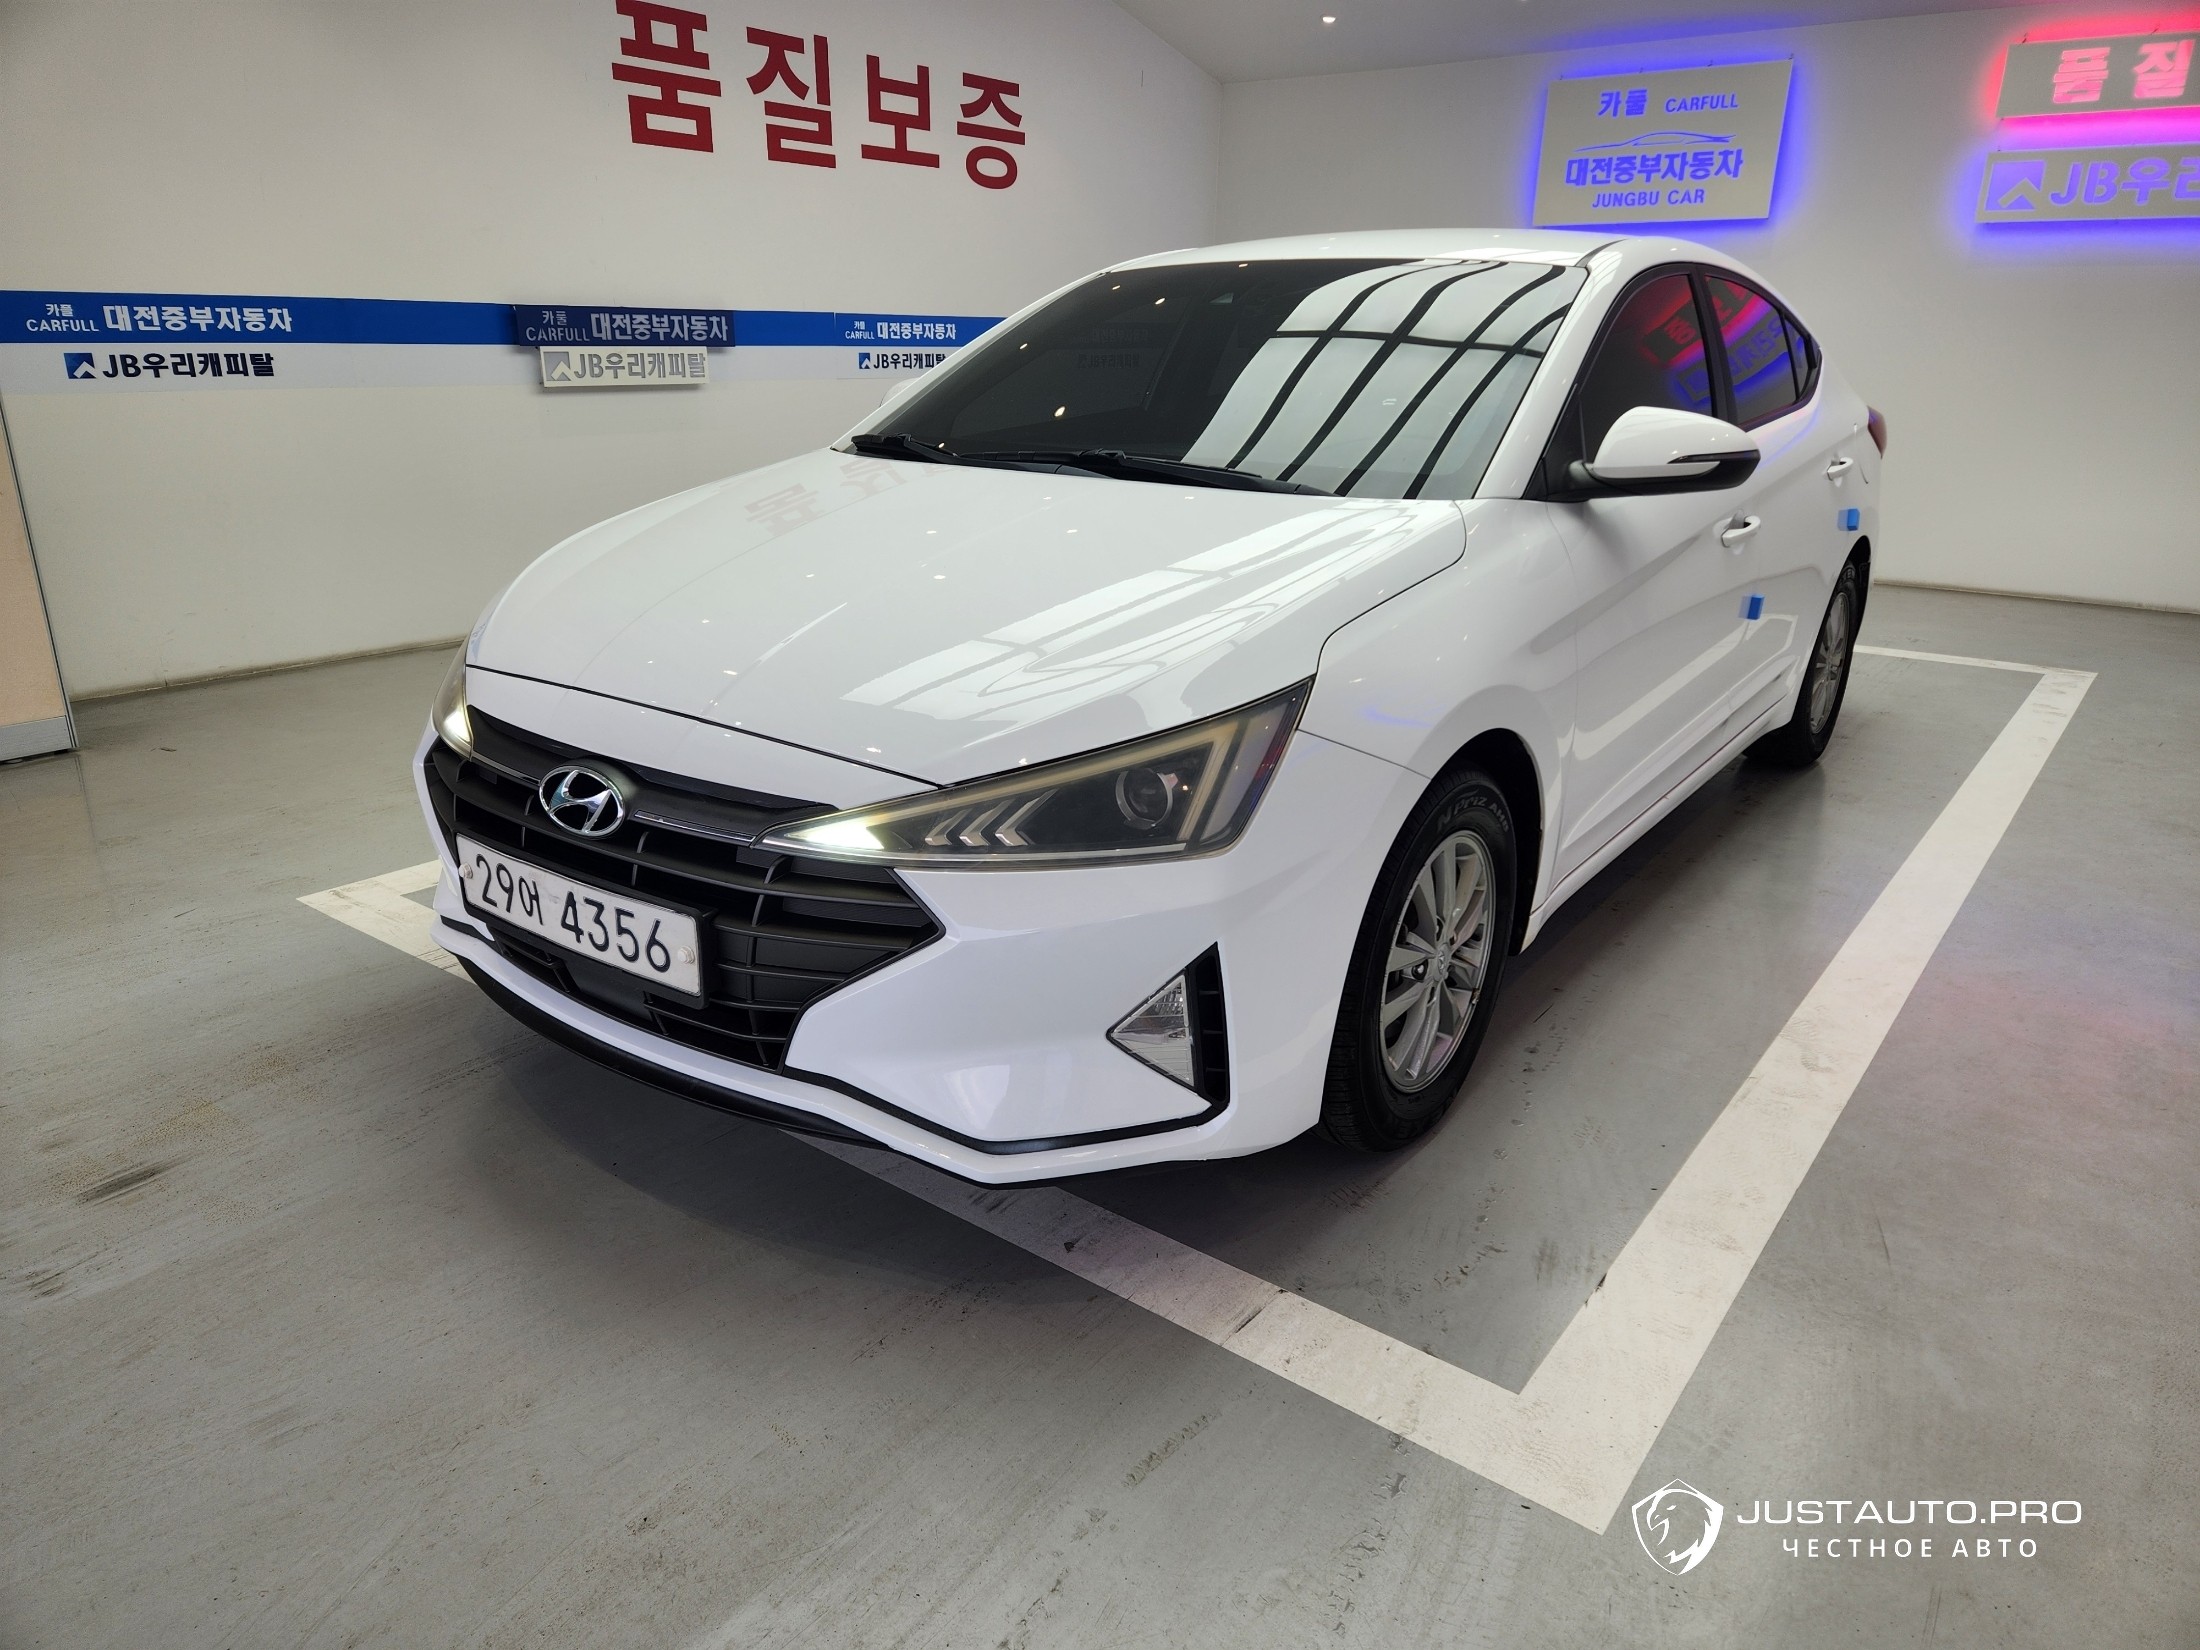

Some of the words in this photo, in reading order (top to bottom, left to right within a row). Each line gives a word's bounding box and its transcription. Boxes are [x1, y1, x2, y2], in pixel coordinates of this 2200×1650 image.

[612, 0, 1026, 190] 품질보증
[1665, 93, 1738, 113] CARFULL
[1565, 149, 1743, 187] 대전중부자동차
[1592, 190, 1660, 208] JUNGBU
[1667, 189, 1705, 205] CAR
[26, 319, 100, 332] CARFULL
[102, 305, 293, 332] 대전중부자동차
[526, 326, 590, 342] CARFULL
[590, 313, 728, 341] 대전중부자동차
[845, 330, 875, 340] CARFULL
[877, 322, 957, 340] 대전중부자동차
[102, 352, 275, 378] JB우리캐피탈
[573, 352, 707, 379] JB우리캐피탈
[476, 854, 544, 926] 29어
[561, 891, 671, 973] 4356
